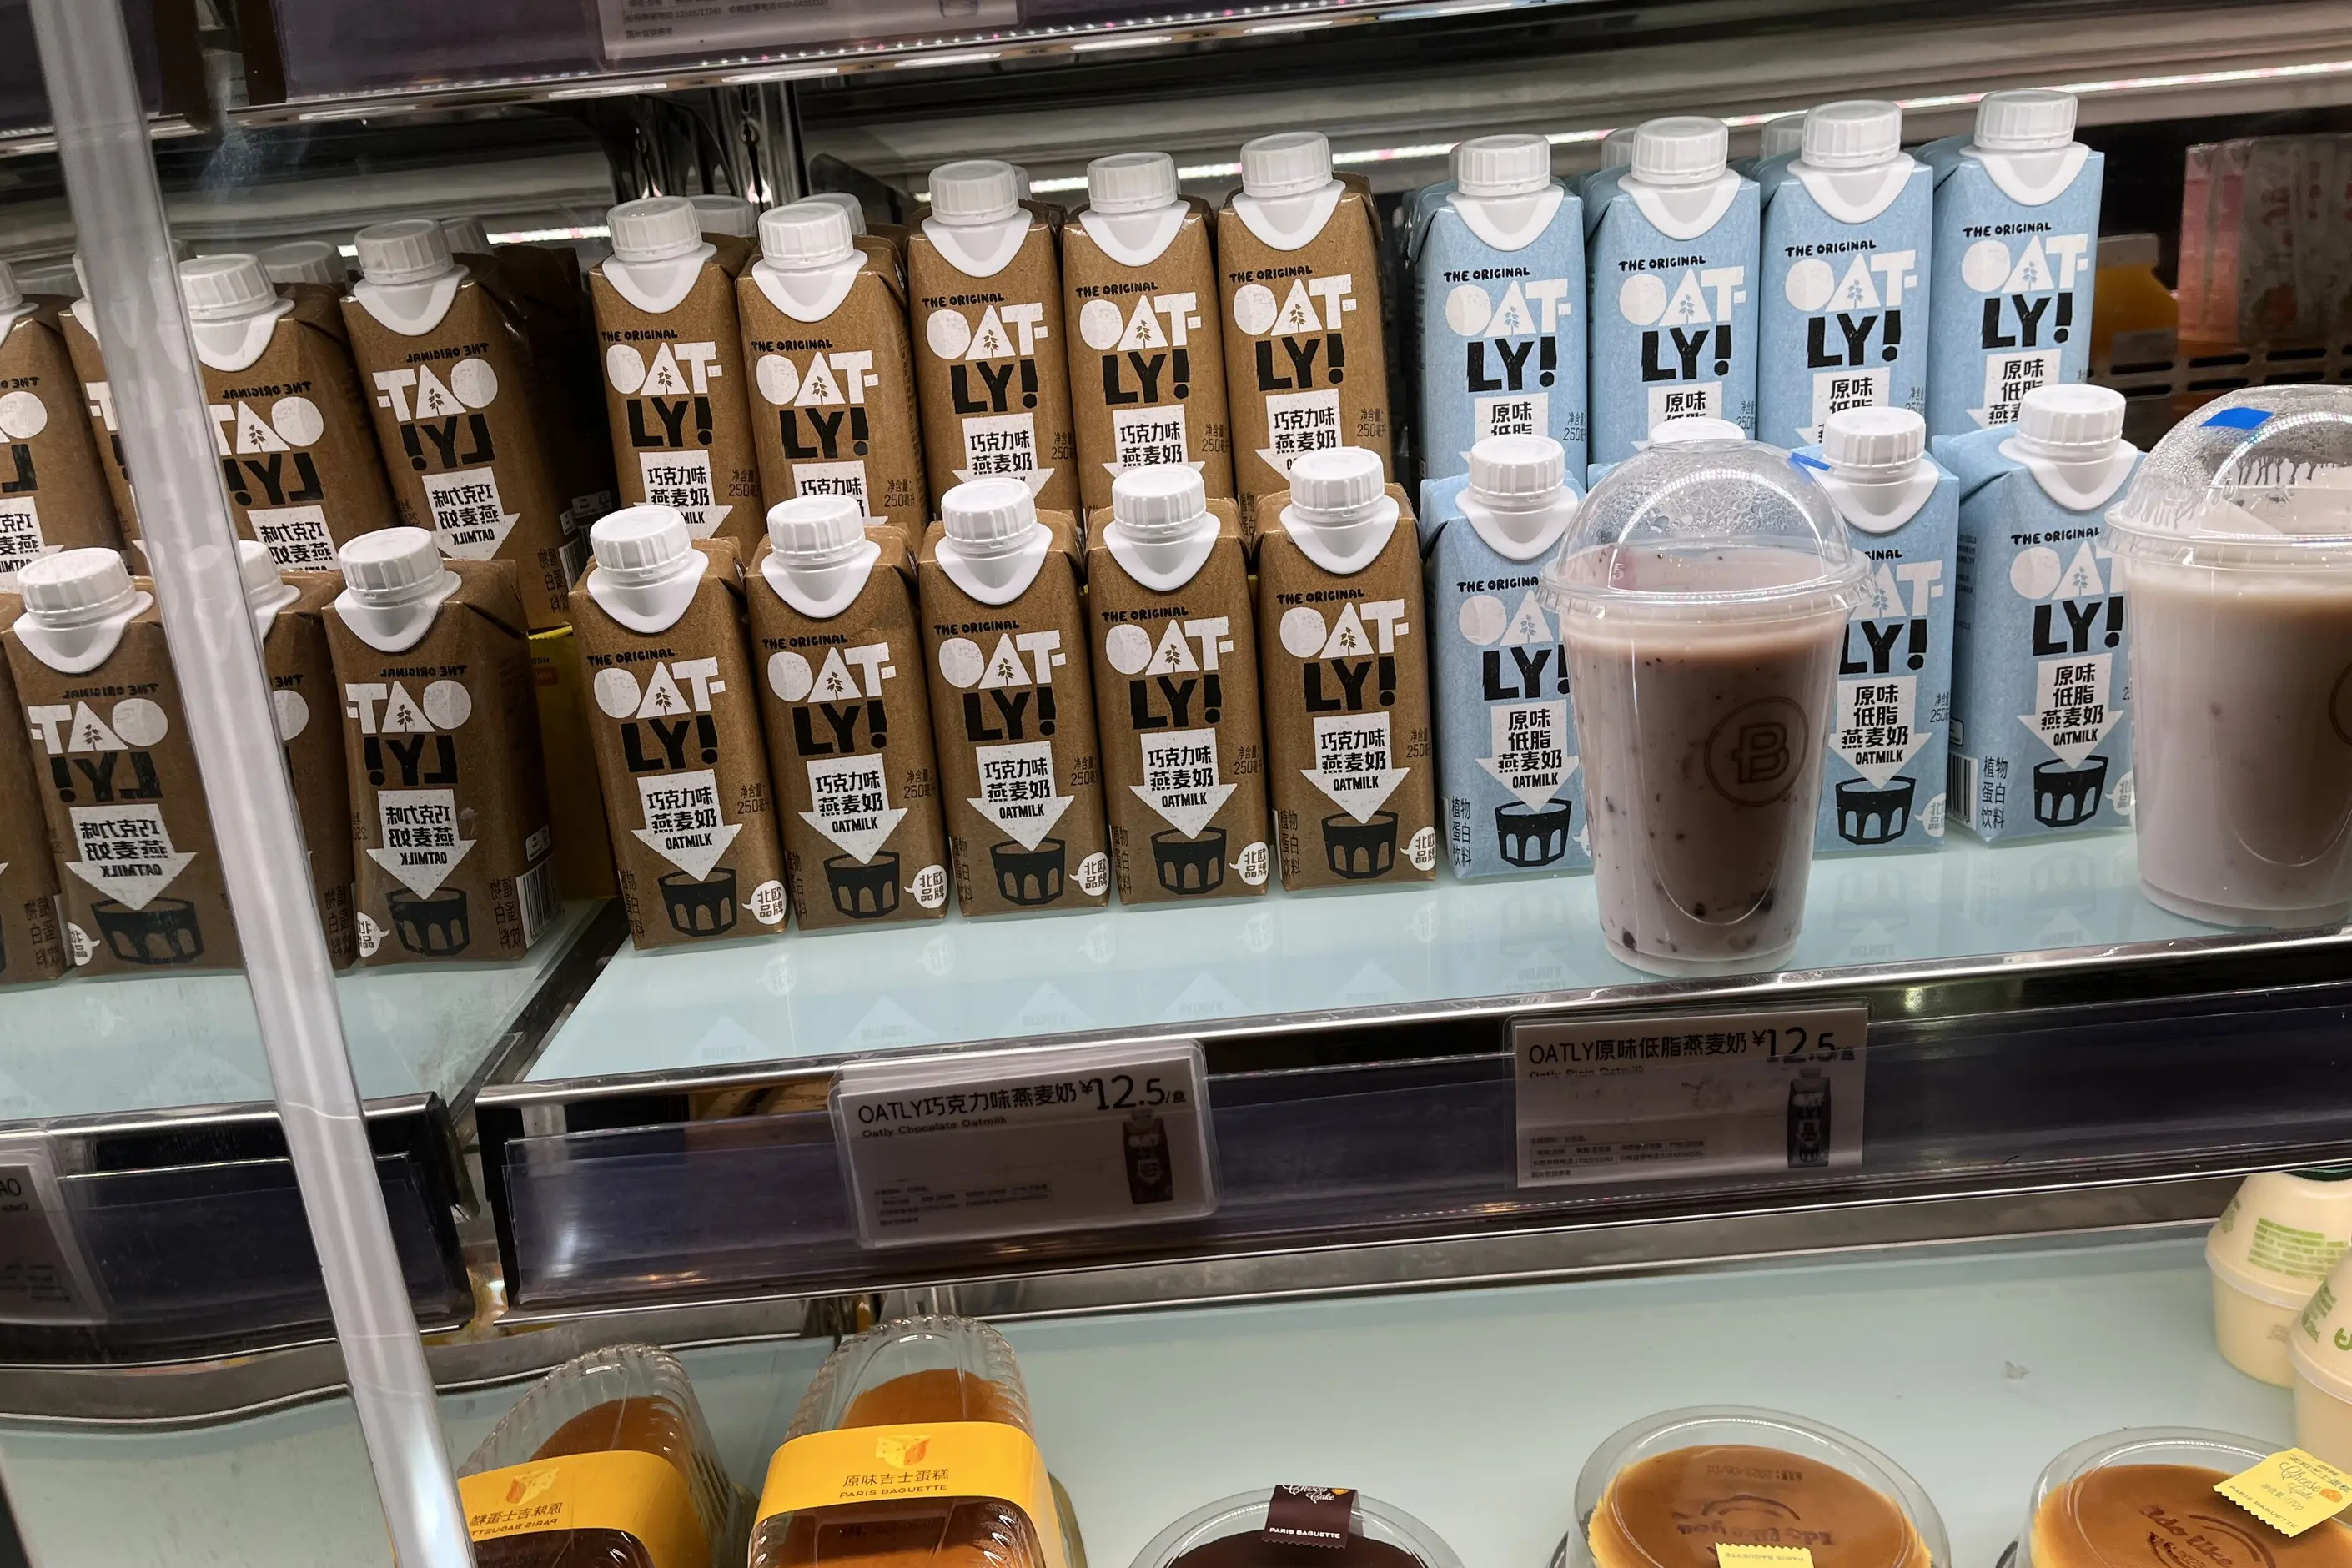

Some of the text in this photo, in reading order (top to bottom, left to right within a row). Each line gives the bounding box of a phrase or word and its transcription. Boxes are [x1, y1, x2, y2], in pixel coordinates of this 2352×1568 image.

[1963, 223, 2052, 239] THE ORIGINAL
[1786, 240, 1877, 257] THE ORIGINAL
[1229, 265, 1313, 283] THE ORIGINAL
[1444, 267, 1530, 282] THE ORIGINAL
[1619, 256, 1706, 272] THE ORIGINAL
[1076, 282, 1158, 298] THE ORIGINAL
[922, 294, 1004, 308] THE ORIGINAL
[1982, 292, 2073, 349] LY!
[601, 329, 677, 341] THE ORIGINAL
[751, 339, 833, 352] THE ORIGINAL
[1807, 310, 1901, 368] LY!
[1255, 334, 1344, 391] LY!
[1641, 324, 1731, 382] LY!
[1467, 336, 1557, 392] LY!
[2003, 359, 2044, 380] 原味
[950, 359, 1038, 415] LY!
[1103, 349, 1190, 405] LY!
[1831, 378, 1873, 400] 原味
[1665, 390, 1706, 413] 原味
[626, 397, 712, 447] LY!
[1274, 408, 1334, 429] 巧克力味
[1491, 402, 1532, 423] 原味
[779, 407, 869, 459] LY!
[970, 431, 1030, 451] 巧克力味
[1120, 422, 1180, 443] 巧克力味
[1276, 431, 1336, 454] 燕麦奶
[972, 453, 1032, 474] 燕麦奶
[1123, 445, 1182, 467] 燕麦奶
[648, 466, 707, 485] 巧克力味
[802, 479, 862, 495] 巧克力味
[651, 489, 709, 507] 燕麦奶
[2011, 533, 2041, 545] THE
[1277, 589, 1364, 604] THE ORIGINAL
[1457, 580, 1485, 592] THE
[1102, 607, 1189, 622] THE ORIGINAL
[934, 620, 1020, 635] THE ORIGINAL
[2033, 596, 2123, 656] LY!
[762, 634, 848, 649] THE ORIGINAL
[1838, 619, 1927, 675] LY!
[587, 649, 675, 666] THE ORIGINAL
[1304, 656, 1396, 712] LY!
[2053, 663, 2095, 686] 原味
[1129, 674, 1222, 730] LY!
[1854, 684, 1898, 706] 原味
[2053, 685, 2094, 707] 低脂
[963, 686, 1056, 742] LY!
[1509, 709, 1550, 730] 原味
[1854, 706, 1897, 727] 低脂
[2041, 706, 2103, 731] 燕麦奶
[792, 700, 887, 756] LY!
[1842, 726, 1908, 749] 燕麦奶
[2053, 728, 2098, 746] OATMILK
[621, 715, 718, 772] LY!
[1321, 729, 1385, 751] 巧克力味
[1508, 731, 1550, 751] 低脂
[1148, 746, 1211, 766] 巧克力味
[1323, 751, 1386, 775] 燕麦奶
[1498, 750, 1562, 773] 燕麦奶
[1855, 749, 1902, 765] OATMILK
[984, 758, 1048, 780] 巧克力味
[1983, 756, 2008, 780] 植物
[816, 771, 880, 793] 巧克力味
[1150, 767, 1214, 791] 燕麦奶
[1334, 775, 1379, 791] OATMILK
[1512, 772, 1558, 789] OATMILK
[647, 787, 713, 810] 巧克力味
[987, 779, 1051, 802] 燕麦奶
[1162, 792, 1207, 807] OATMILK
[1982, 781, 2006, 804] 蛋白
[819, 793, 883, 817] 燕麦奶
[999, 803, 1044, 819] OATMILK
[651, 808, 717, 833] 燕麦奶
[832, 817, 878, 833] OATMILK
[1981, 807, 2005, 829] 饮料
[666, 833, 712, 850] OATMILK
[920, 872, 943, 887] 北欧
[757, 887, 781, 903] 北欧
[760, 903, 783, 917] 品牌
[1529, 1030, 1747, 1065] OATLY原味低脂燕麦奶
[857, 1079, 1077, 1124] OATLY巧克力味燕麦奶
[862, 1115, 1008, 1138] Oatly Chocolate Oatmilk
[843, 1468, 950, 1488] 原味吉士蛋糕
[2279, 1462, 2321, 1493] Cheese
[840, 1484, 947, 1498] PARIS BAGUETTE
[1305, 1492, 1334, 1504] Cake
[2229, 1485, 2299, 1528] PARIS BAGUETTE
[1296, 1530, 1340, 1539] BAGUETTE
